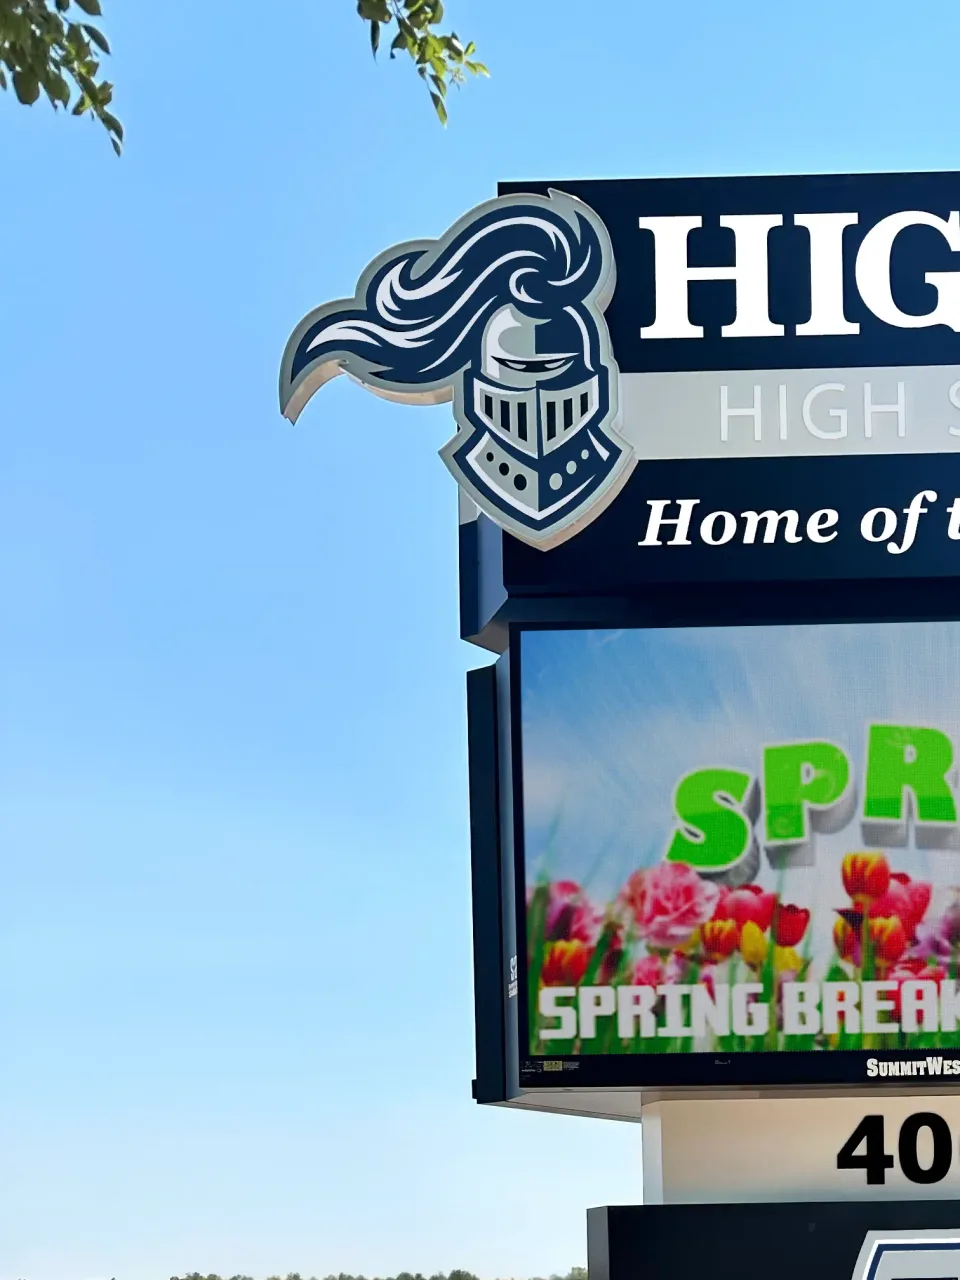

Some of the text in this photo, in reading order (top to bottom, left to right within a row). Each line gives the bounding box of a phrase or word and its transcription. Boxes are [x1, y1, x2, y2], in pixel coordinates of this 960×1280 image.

[720, 381, 906, 441] HIGH
[638, 499, 839, 546] Home
[860, 490, 938, 554] of
[538, 982, 770, 1041] SPRING
